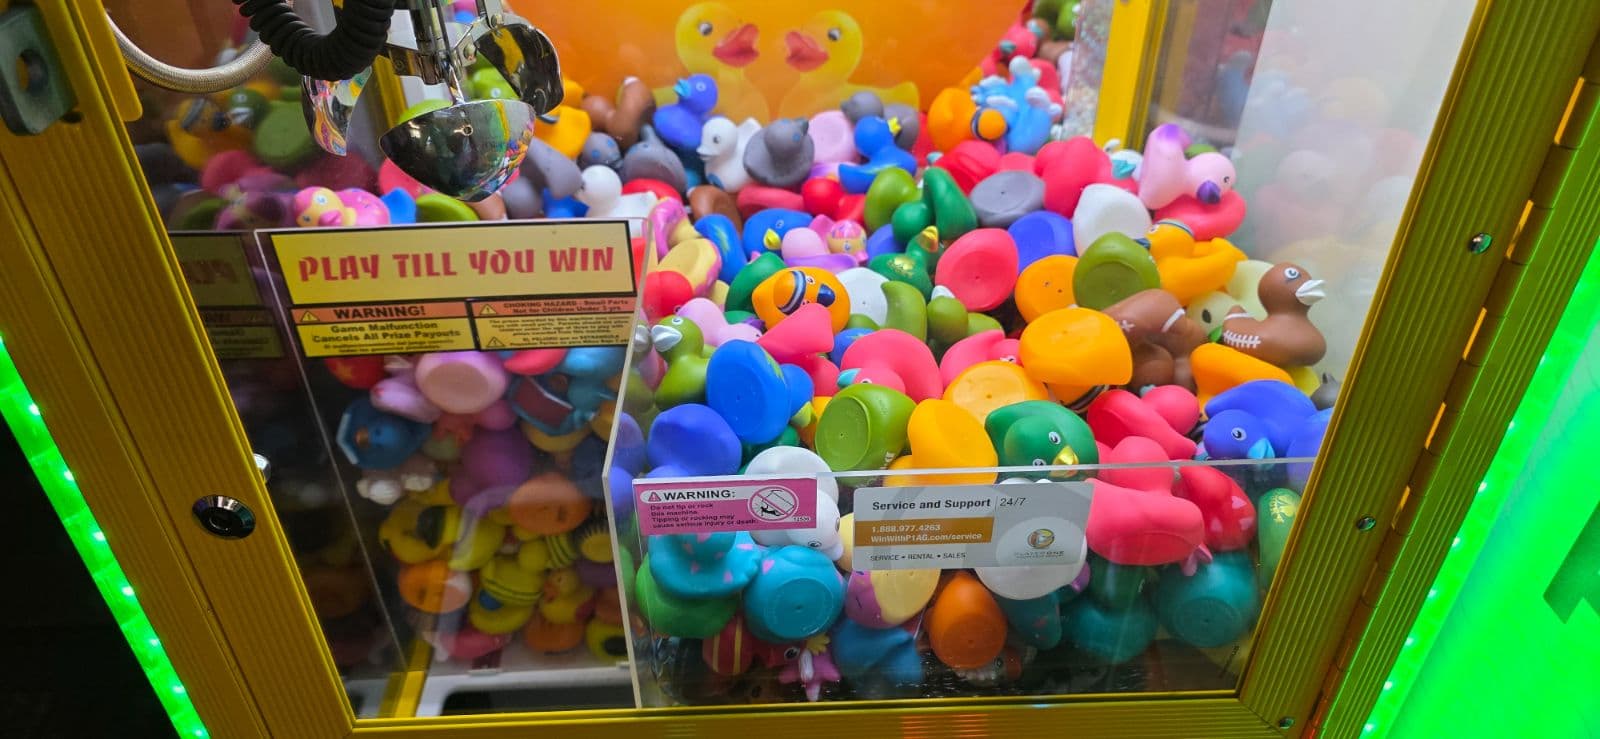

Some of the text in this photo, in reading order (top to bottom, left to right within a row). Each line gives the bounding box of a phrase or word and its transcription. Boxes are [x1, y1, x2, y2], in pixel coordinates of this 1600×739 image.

[298, 246, 614, 282] PLAY TILL YOU WIN
[333, 306, 426, 319] WARNING!
[331, 321, 438, 334] Game Malfunction
[312, 330, 461, 343] Cancels All Prize Payouts
[664, 490, 737, 501] WARNING:
[872, 497, 1026, 511] Service and Support 24/7
[872, 524, 941, 533] 1.888.977.4263
